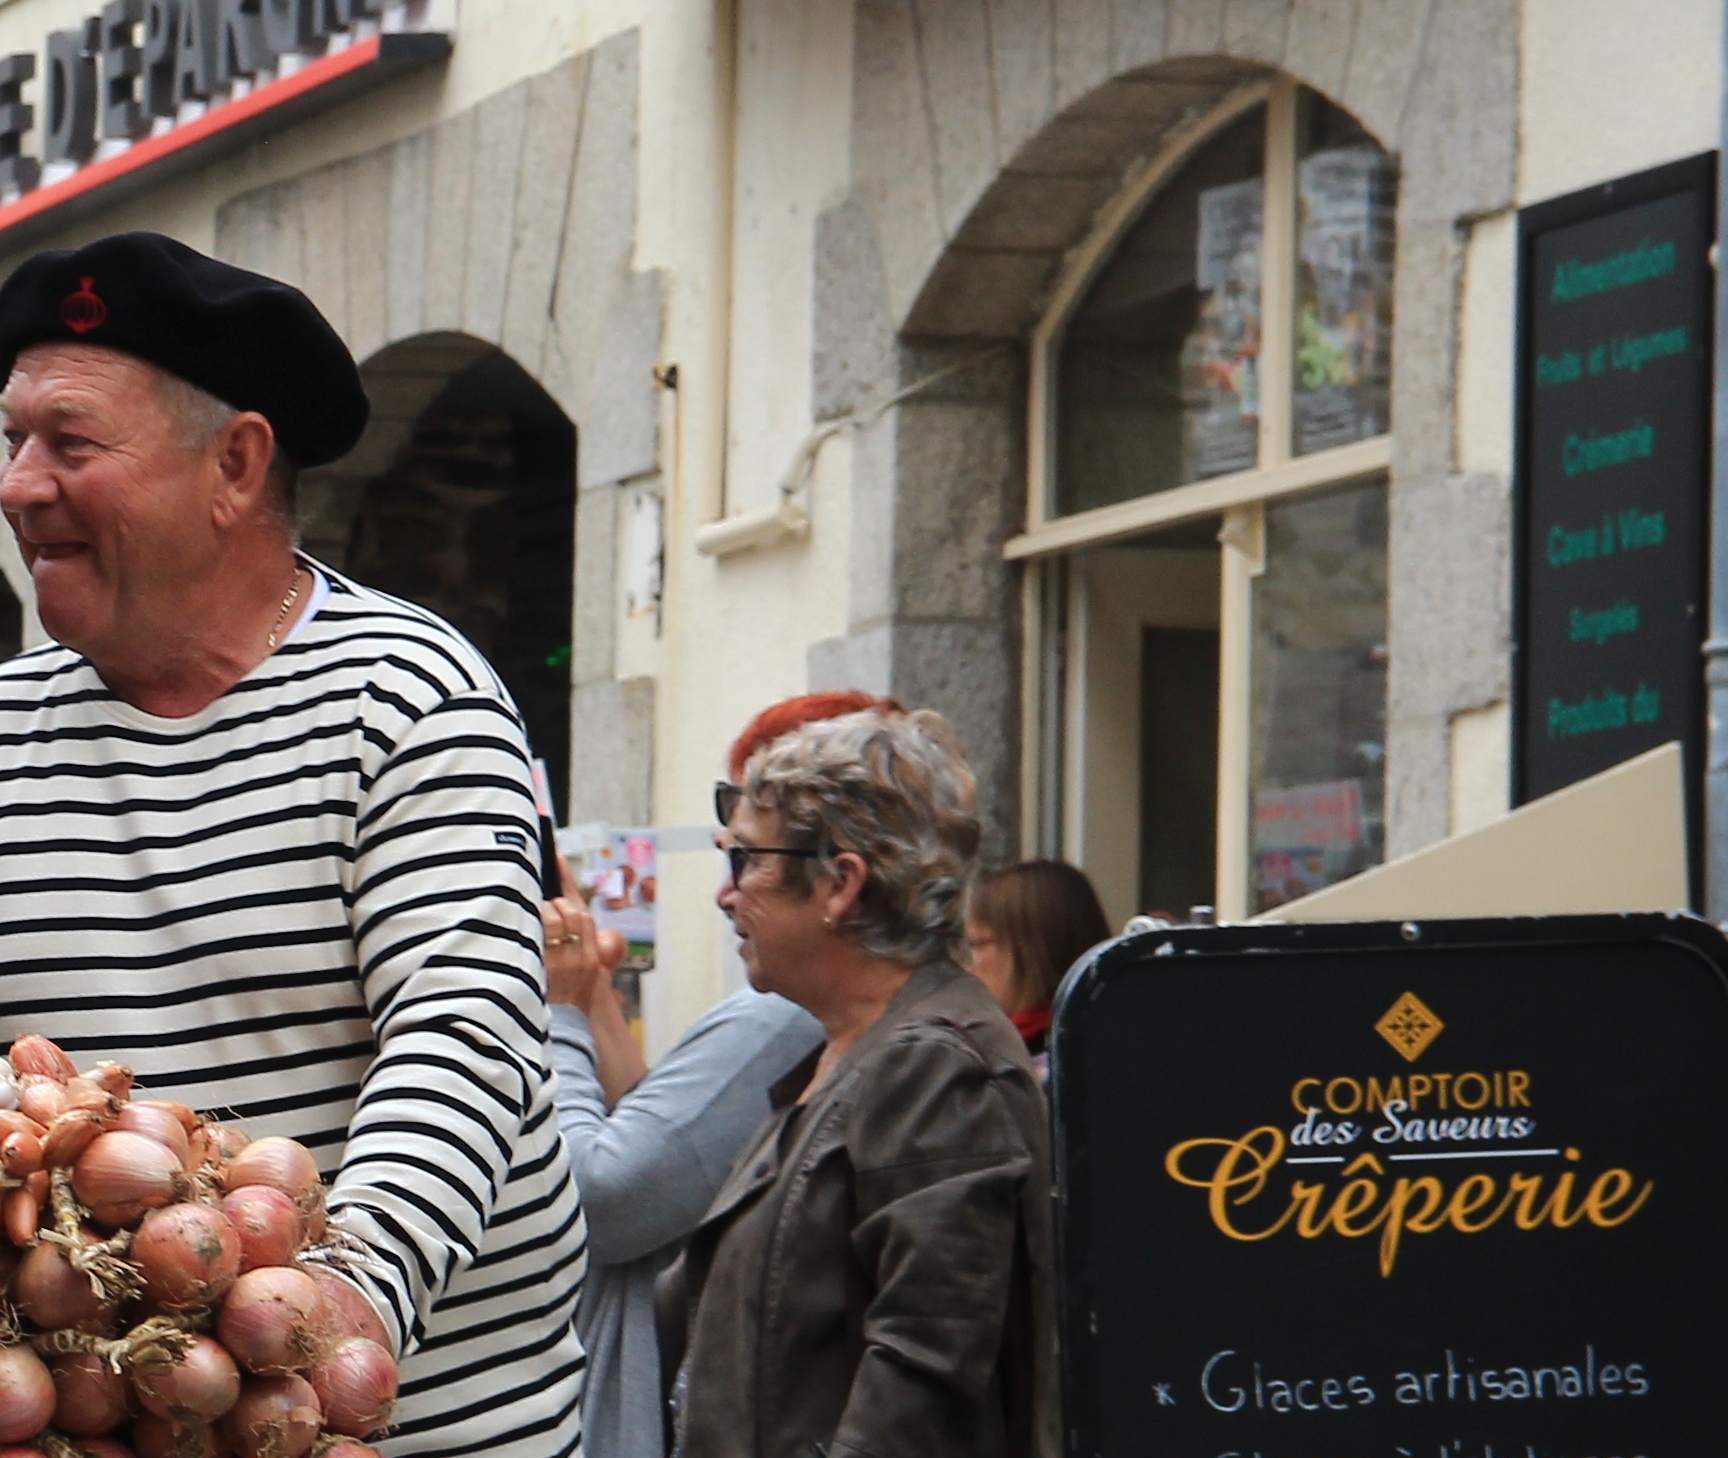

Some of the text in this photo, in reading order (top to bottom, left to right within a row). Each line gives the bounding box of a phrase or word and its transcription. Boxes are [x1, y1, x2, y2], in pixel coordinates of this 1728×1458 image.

[1552, 240, 1676, 302] Alimentation
[1588, 345, 1605, 374] et
[1548, 507, 1665, 566] Cave à Vins
[1548, 681, 1659, 740] Produits du
[1290, 1099, 1536, 1145] des Saveurs
[1291, 1071, 1531, 1114] COMPTOIR
[1165, 1125, 1653, 1278] Crêperie
[1200, 1345, 1650, 1412] Glaces artisanales
